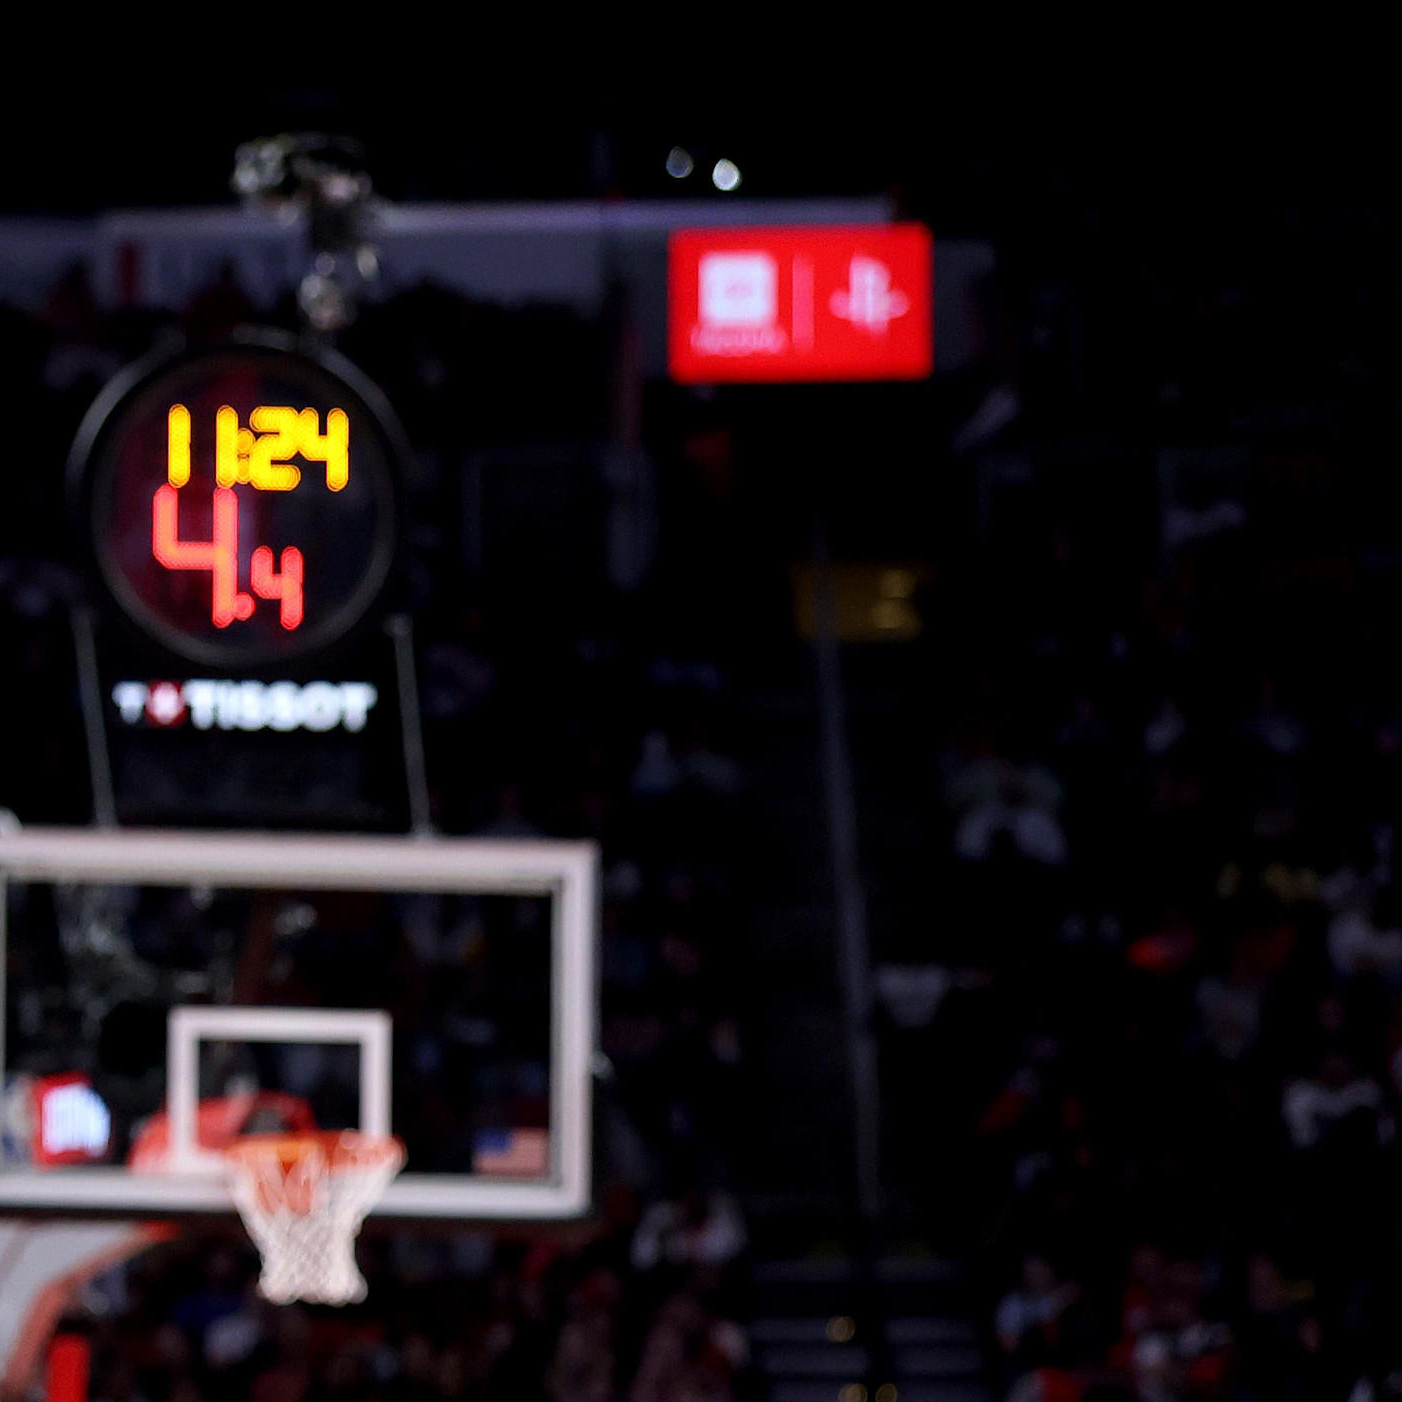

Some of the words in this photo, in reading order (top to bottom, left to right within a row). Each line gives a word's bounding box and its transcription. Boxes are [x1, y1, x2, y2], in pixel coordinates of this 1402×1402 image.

[168, 404, 349, 492] 11:24
[152, 483, 305, 630] 4.4
[183, 679, 378, 733] TISSOT
